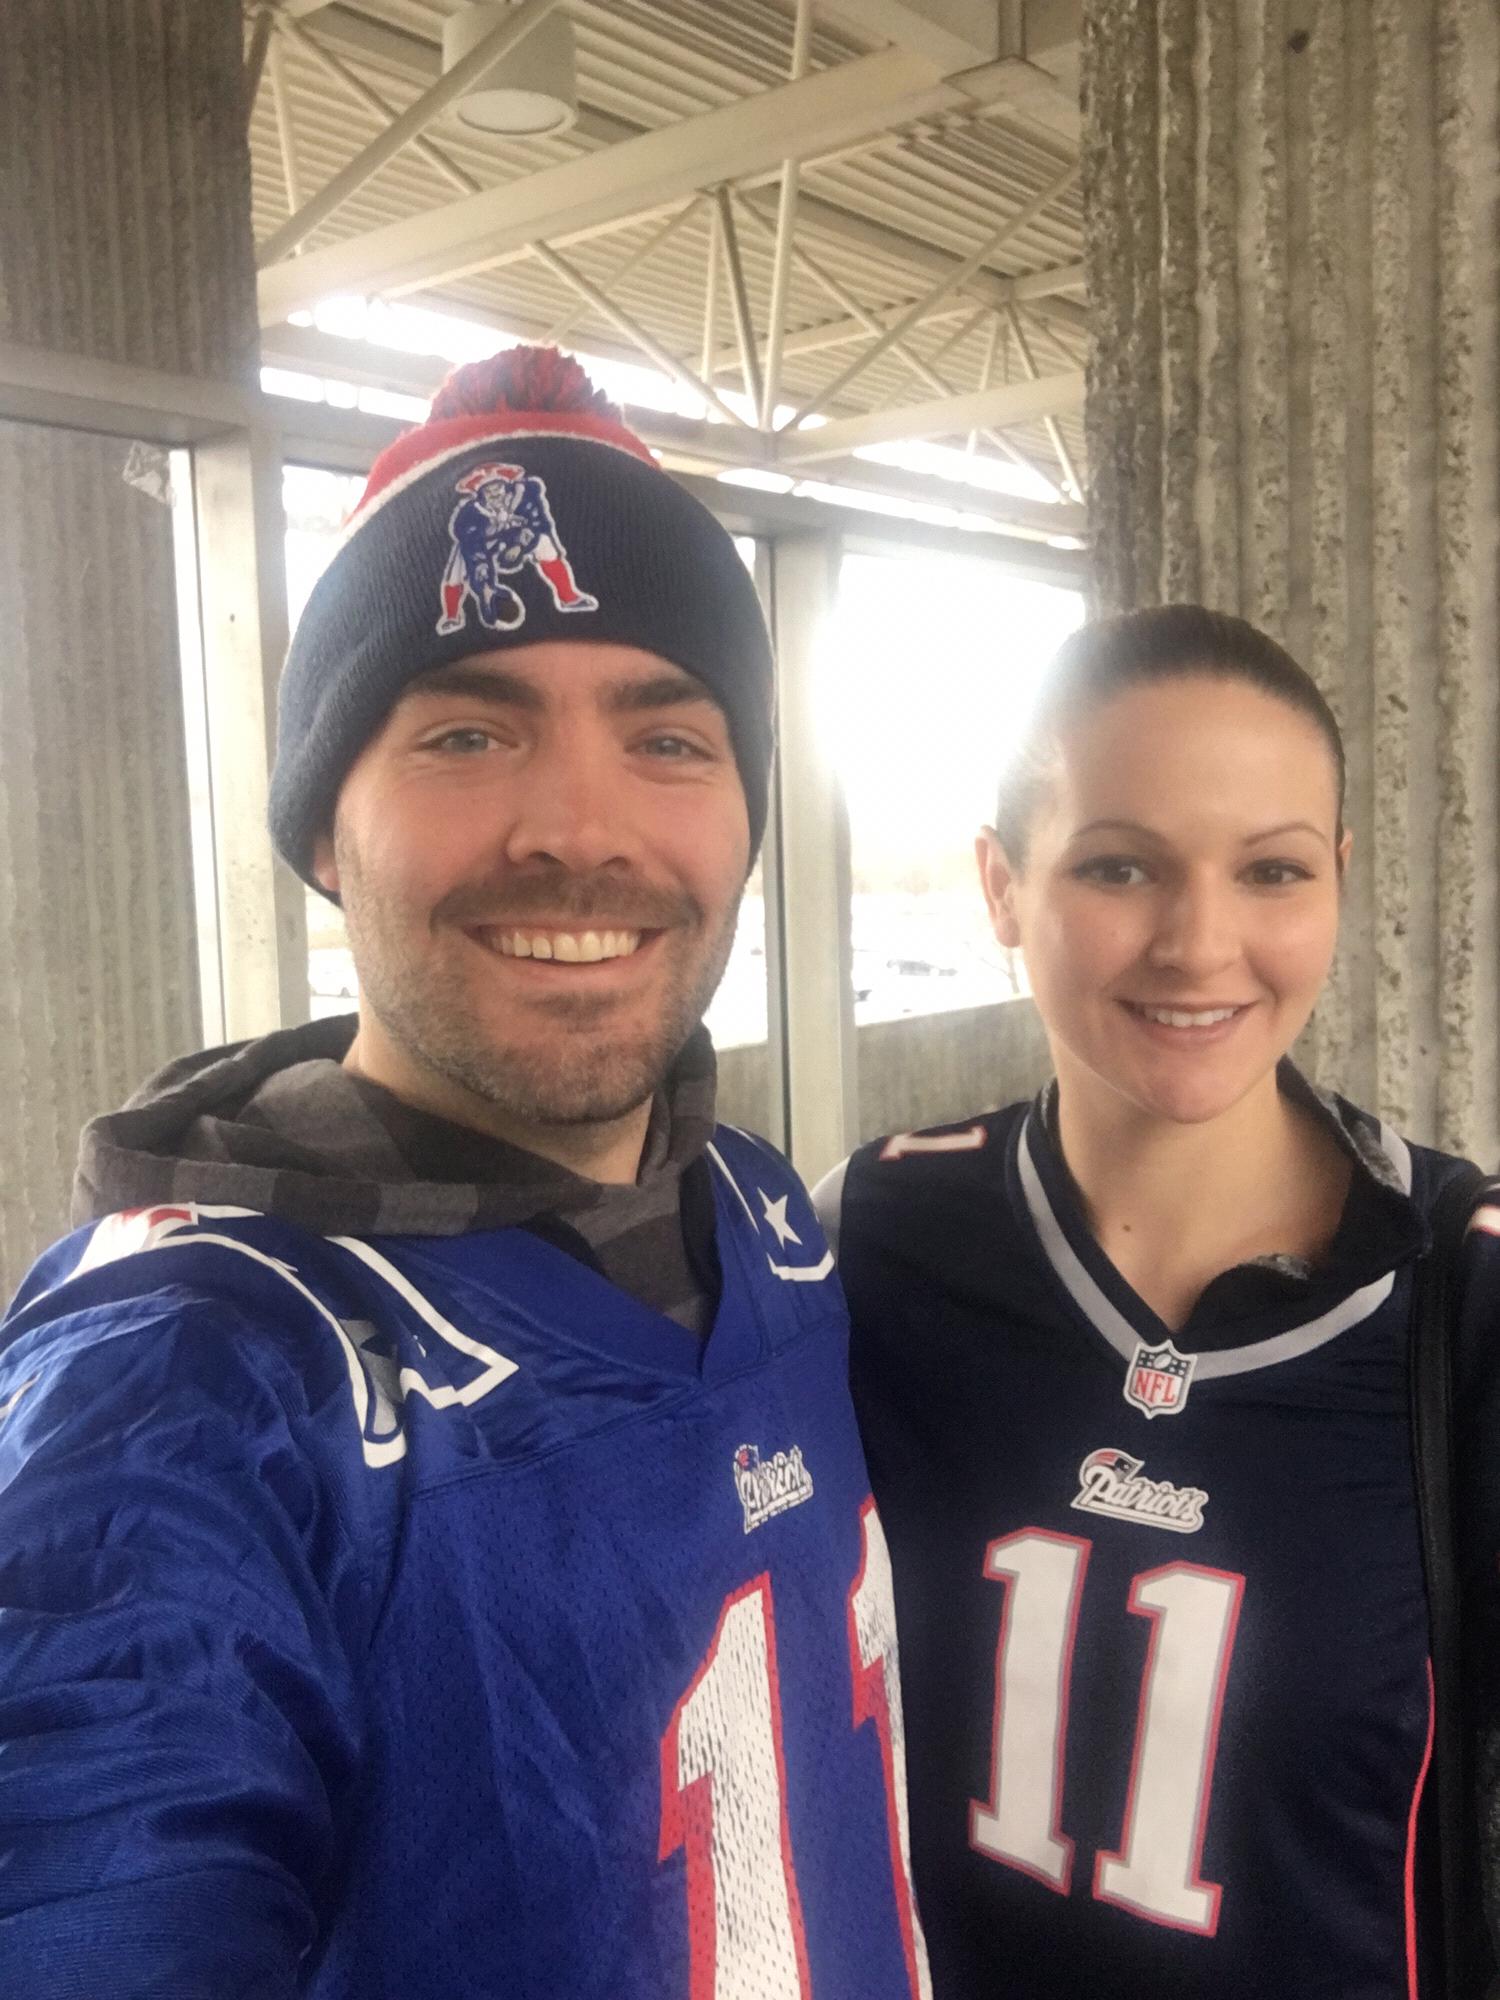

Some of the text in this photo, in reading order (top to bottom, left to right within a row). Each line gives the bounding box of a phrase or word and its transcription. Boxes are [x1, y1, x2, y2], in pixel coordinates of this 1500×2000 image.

[1133, 1370, 1176, 1403] NFL
[1074, 1465, 1208, 1531] Patriots
[970, 1526, 1246, 1937] 11
